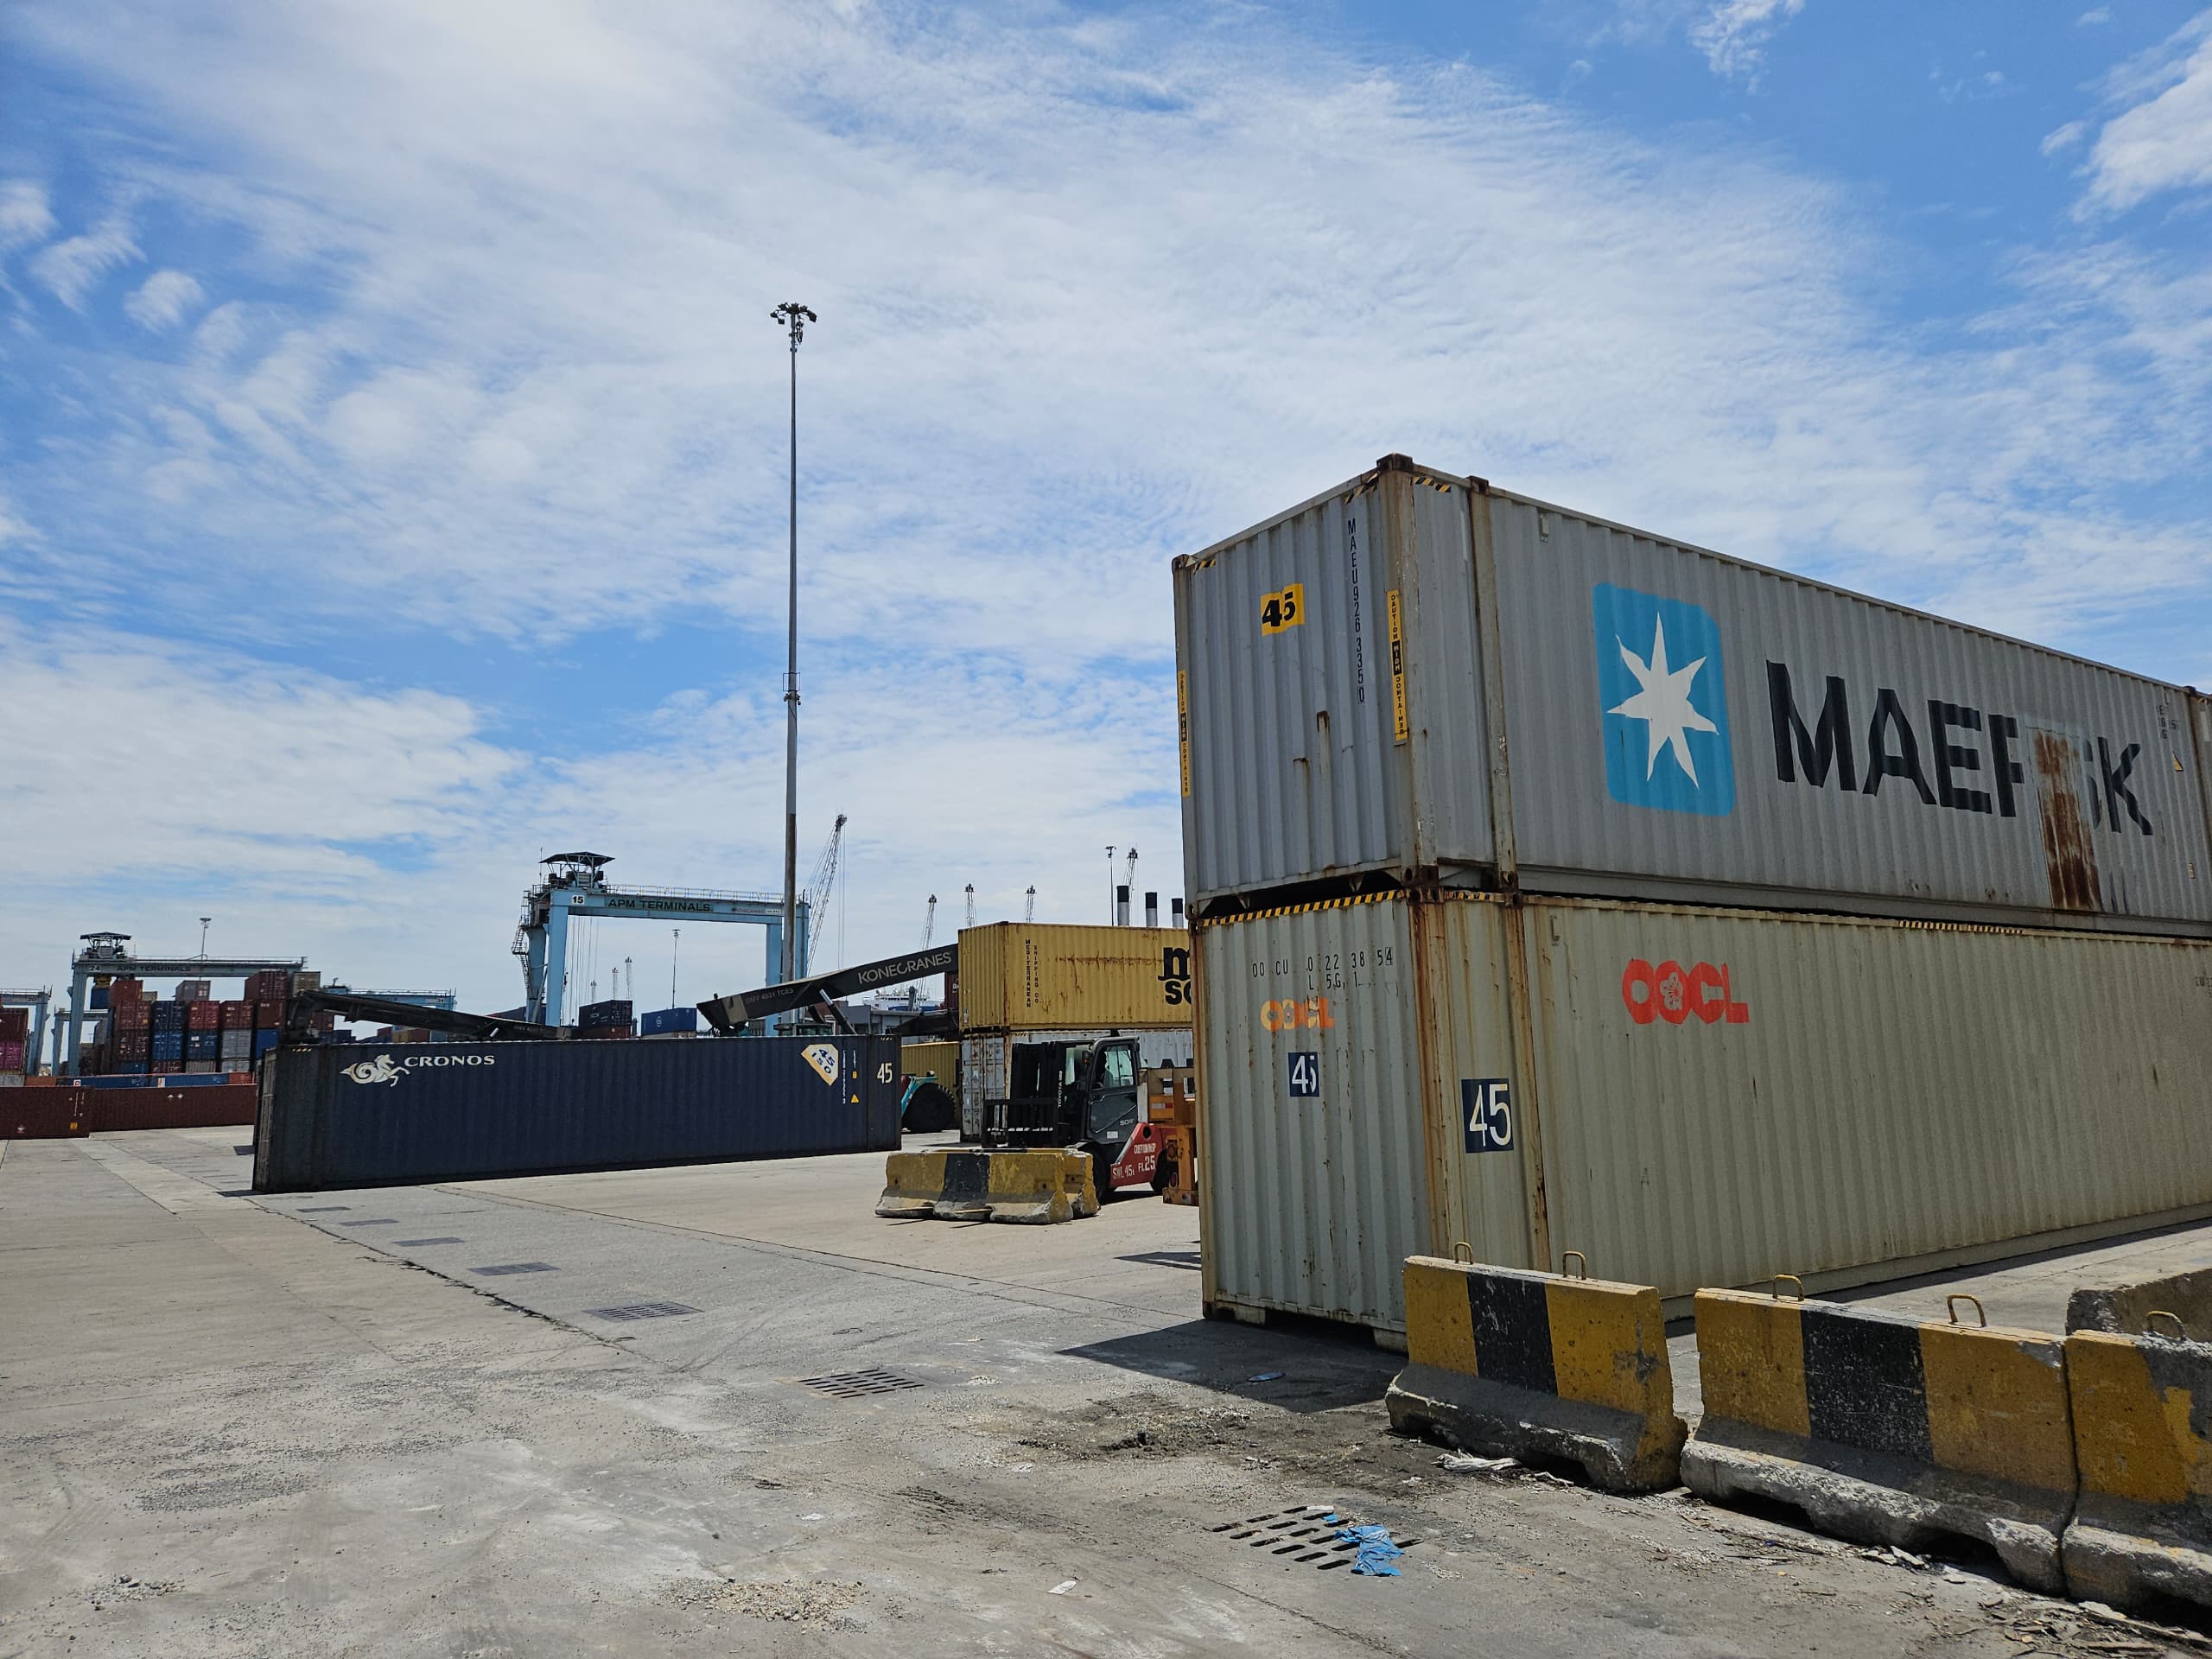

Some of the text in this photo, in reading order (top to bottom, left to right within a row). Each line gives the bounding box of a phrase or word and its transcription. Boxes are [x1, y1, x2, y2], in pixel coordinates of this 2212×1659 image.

[1262, 591, 1296, 627] 45
[608, 899, 635, 908] APM
[640, 899, 710, 912] TERMINALS
[858, 951, 952, 984] KONECRANES
[1621, 959, 1750, 1025] OOCL
[404, 1055, 496, 1067] CRONOS
[811, 1052, 832, 1074] ISO
[819, 1049, 836, 1067] 45
[876, 1062, 893, 1084] 45
[1291, 1055, 1317, 1094] 45
[1469, 1084, 1512, 1147] 45
